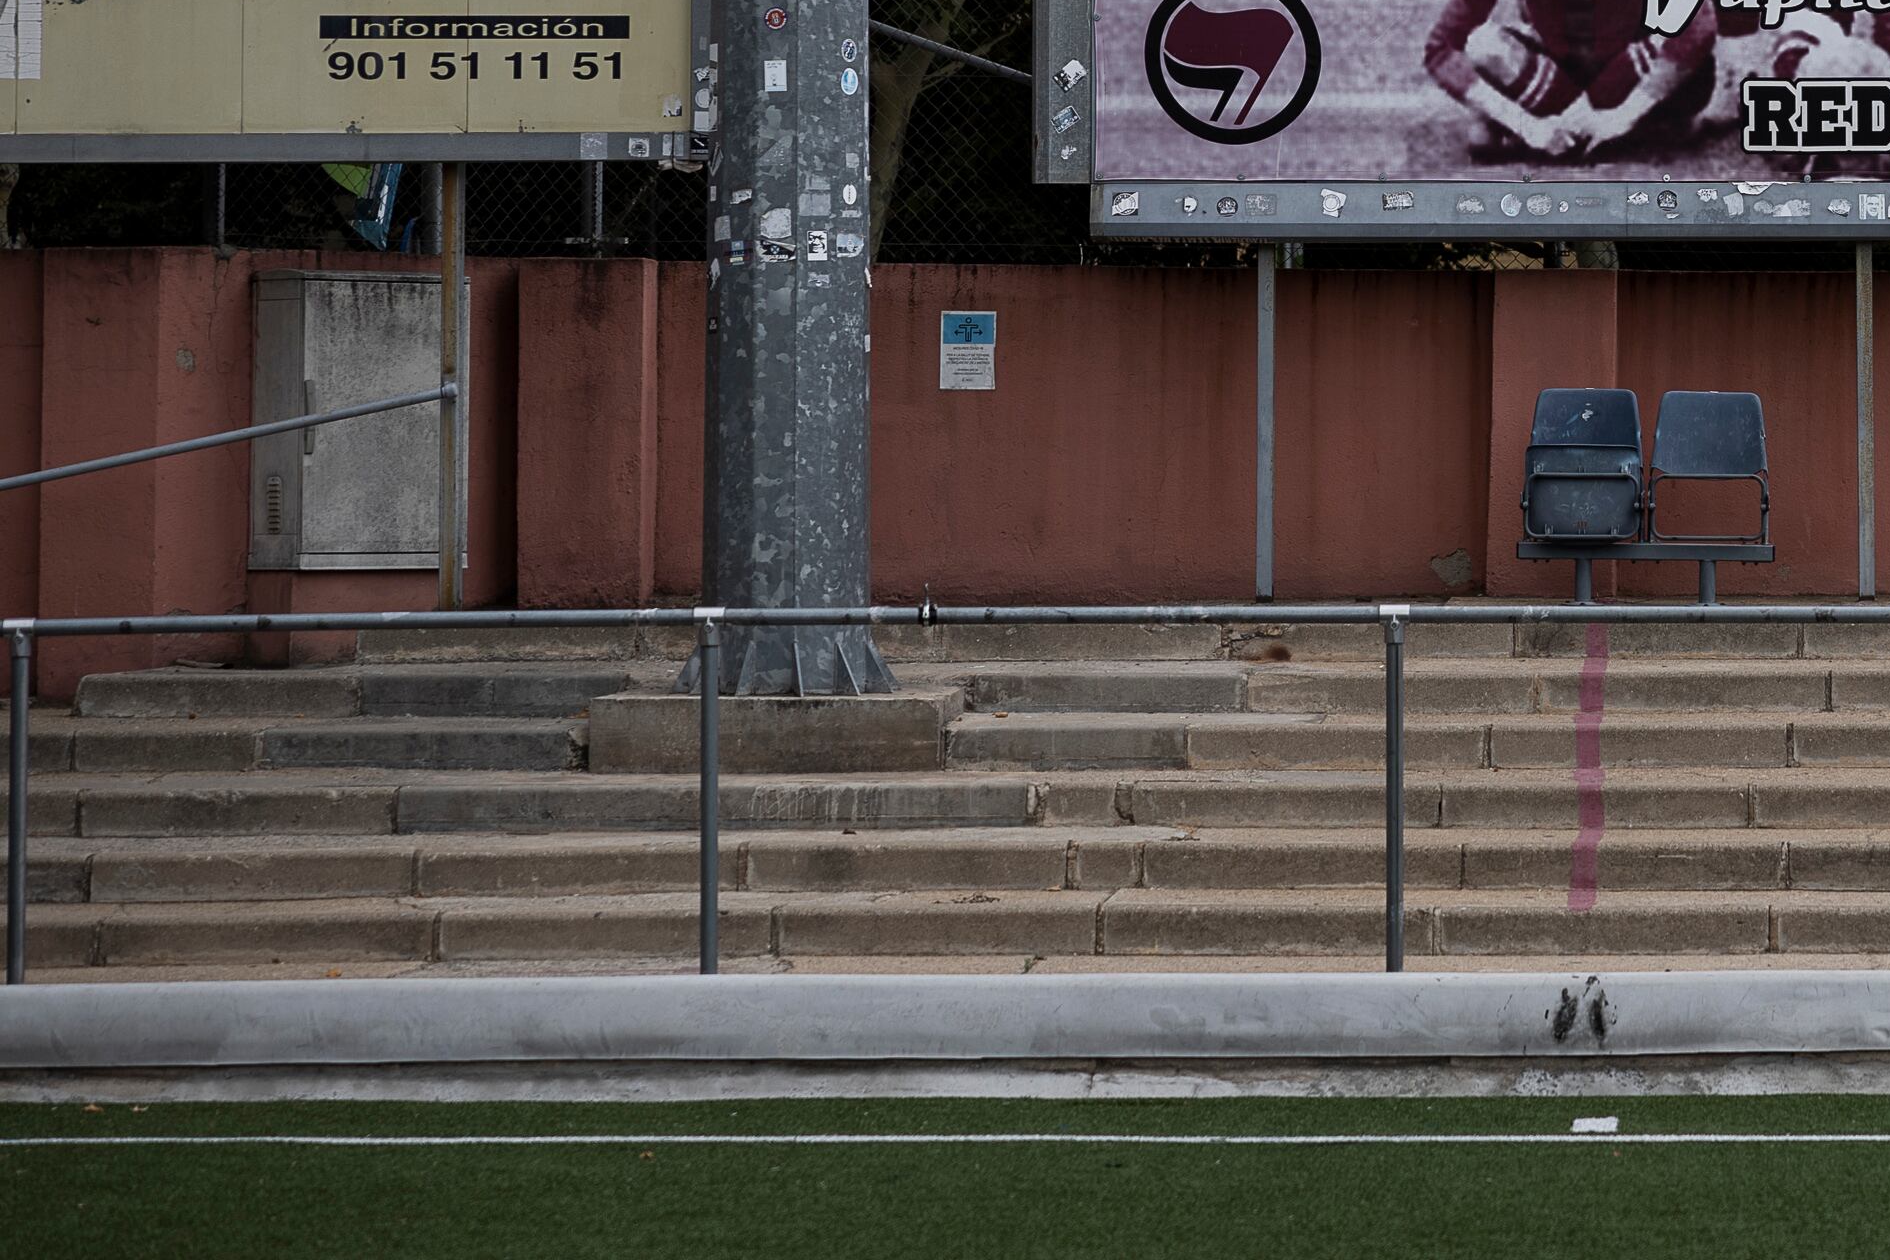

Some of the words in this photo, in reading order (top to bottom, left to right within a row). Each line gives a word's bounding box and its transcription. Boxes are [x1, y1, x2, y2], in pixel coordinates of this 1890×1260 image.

[350, 18, 604, 37] Información
[327, 51, 406, 80] 901
[429, 51, 479, 80] 51
[504, 51, 549, 80] 11
[572, 51, 622, 80] 51
